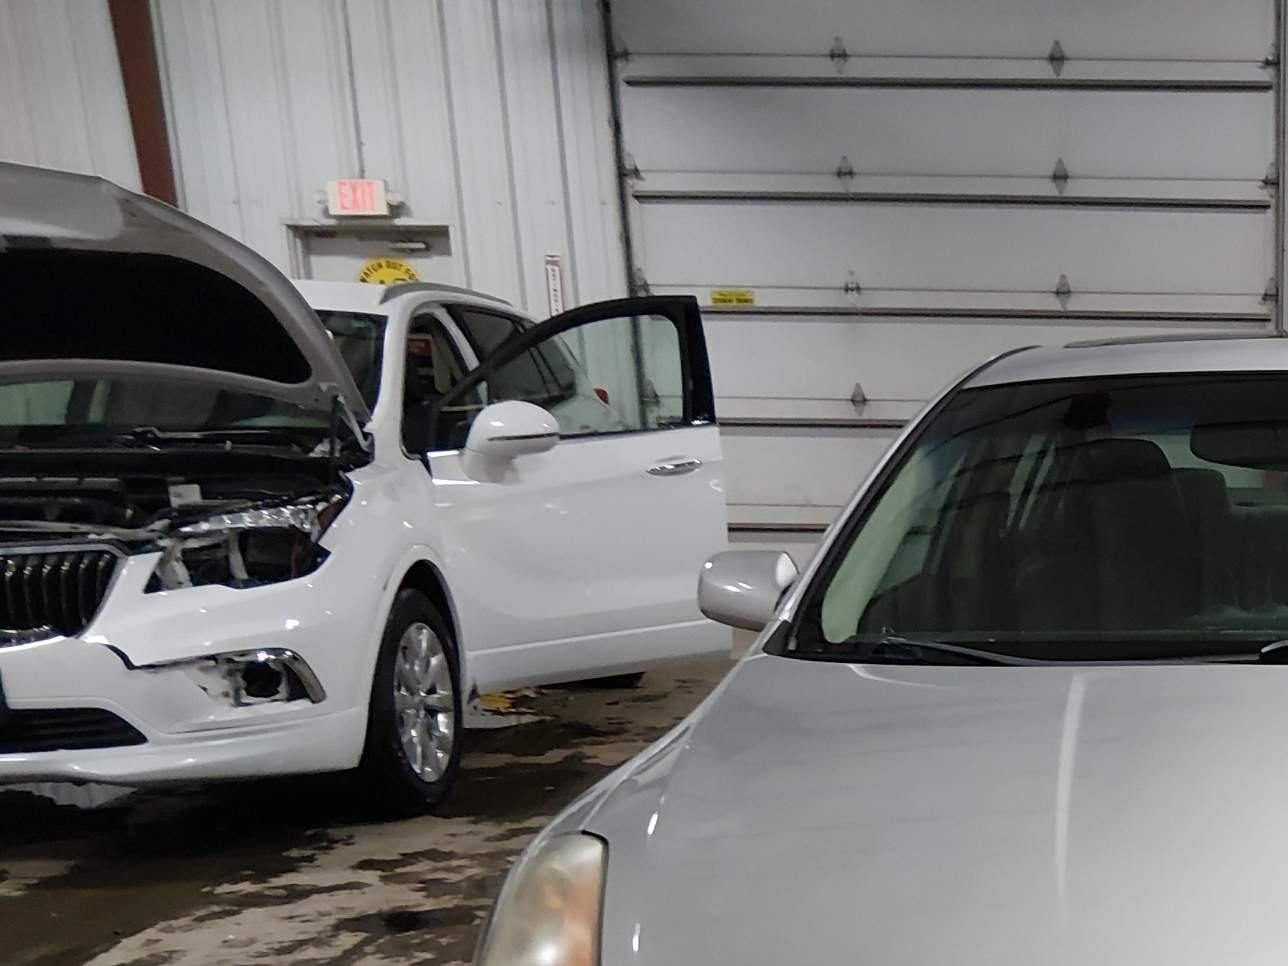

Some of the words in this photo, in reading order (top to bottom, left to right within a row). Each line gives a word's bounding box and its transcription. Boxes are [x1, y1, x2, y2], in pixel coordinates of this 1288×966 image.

[339, 181, 376, 210] EXIT
[359, 261, 384, 283] WATCH
[385, 260, 404, 272] OUT
